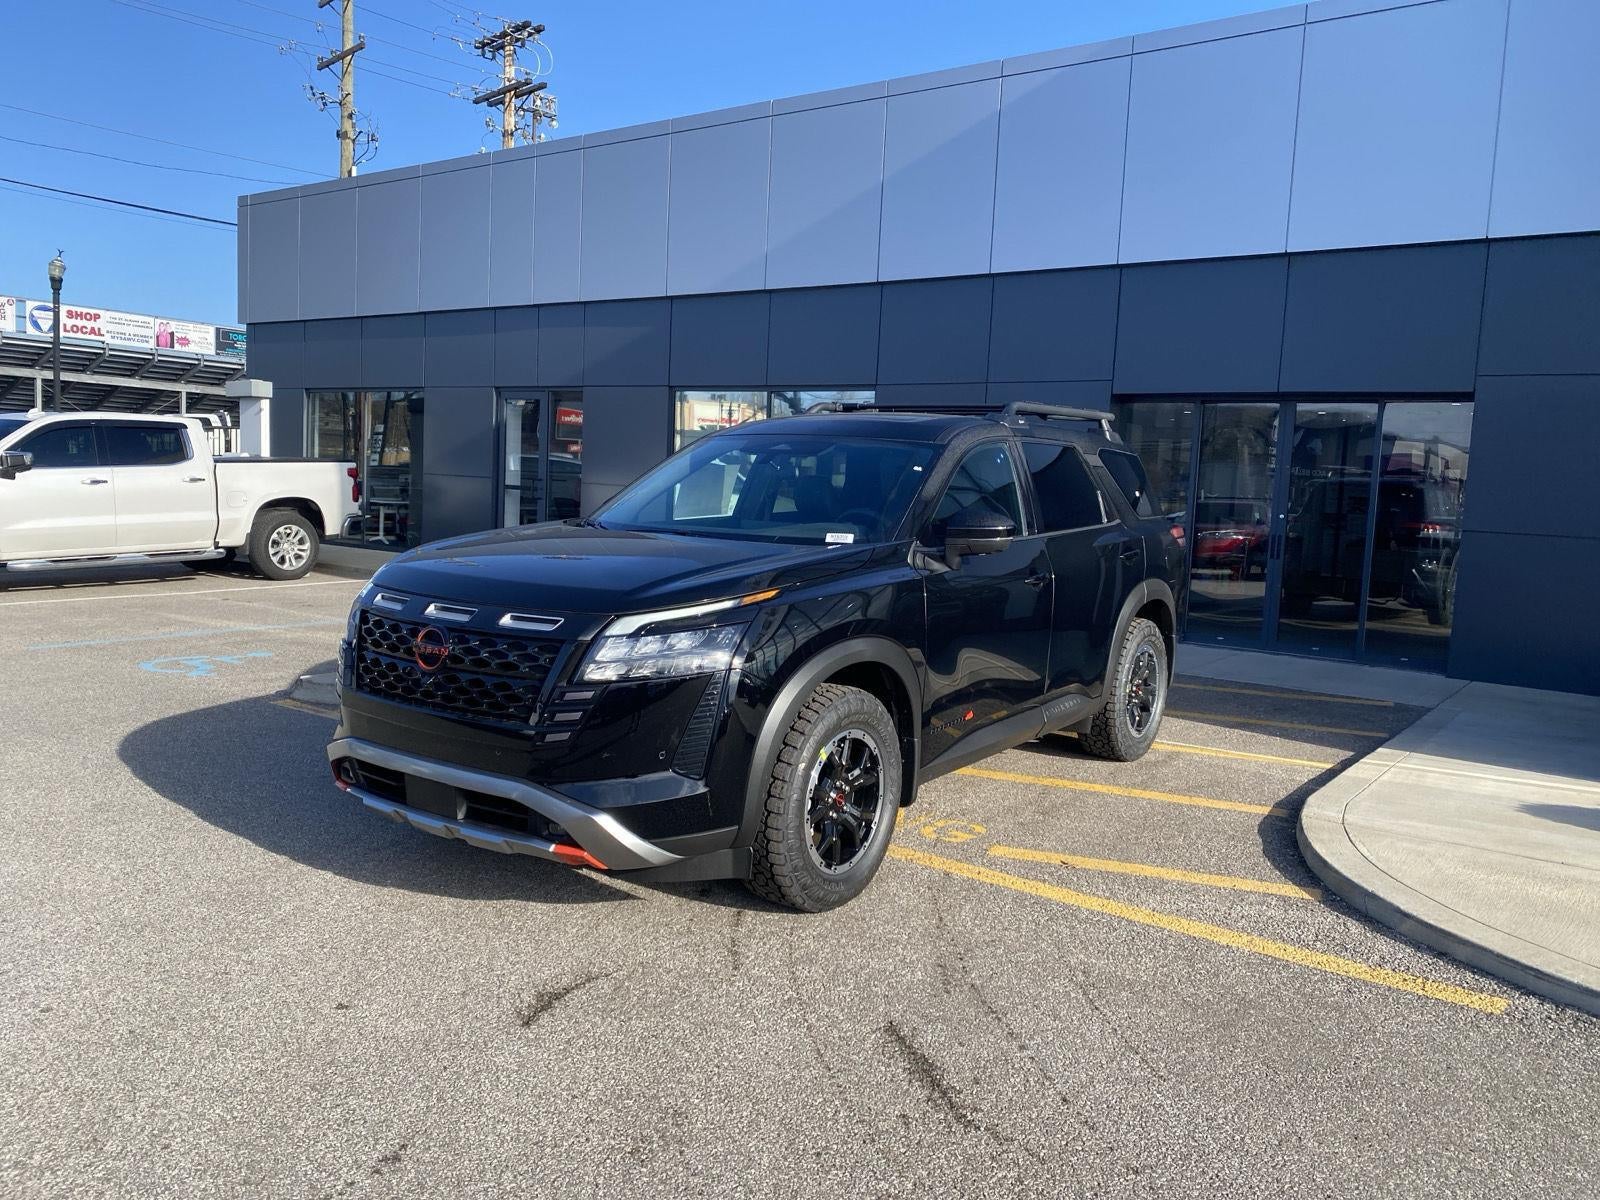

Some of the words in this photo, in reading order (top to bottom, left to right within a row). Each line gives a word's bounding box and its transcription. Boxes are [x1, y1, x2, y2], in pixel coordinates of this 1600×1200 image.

[66, 309, 101, 322] SHOP
[63, 323, 105, 337] LOCAL
[413, 644, 449, 656] SSAN
